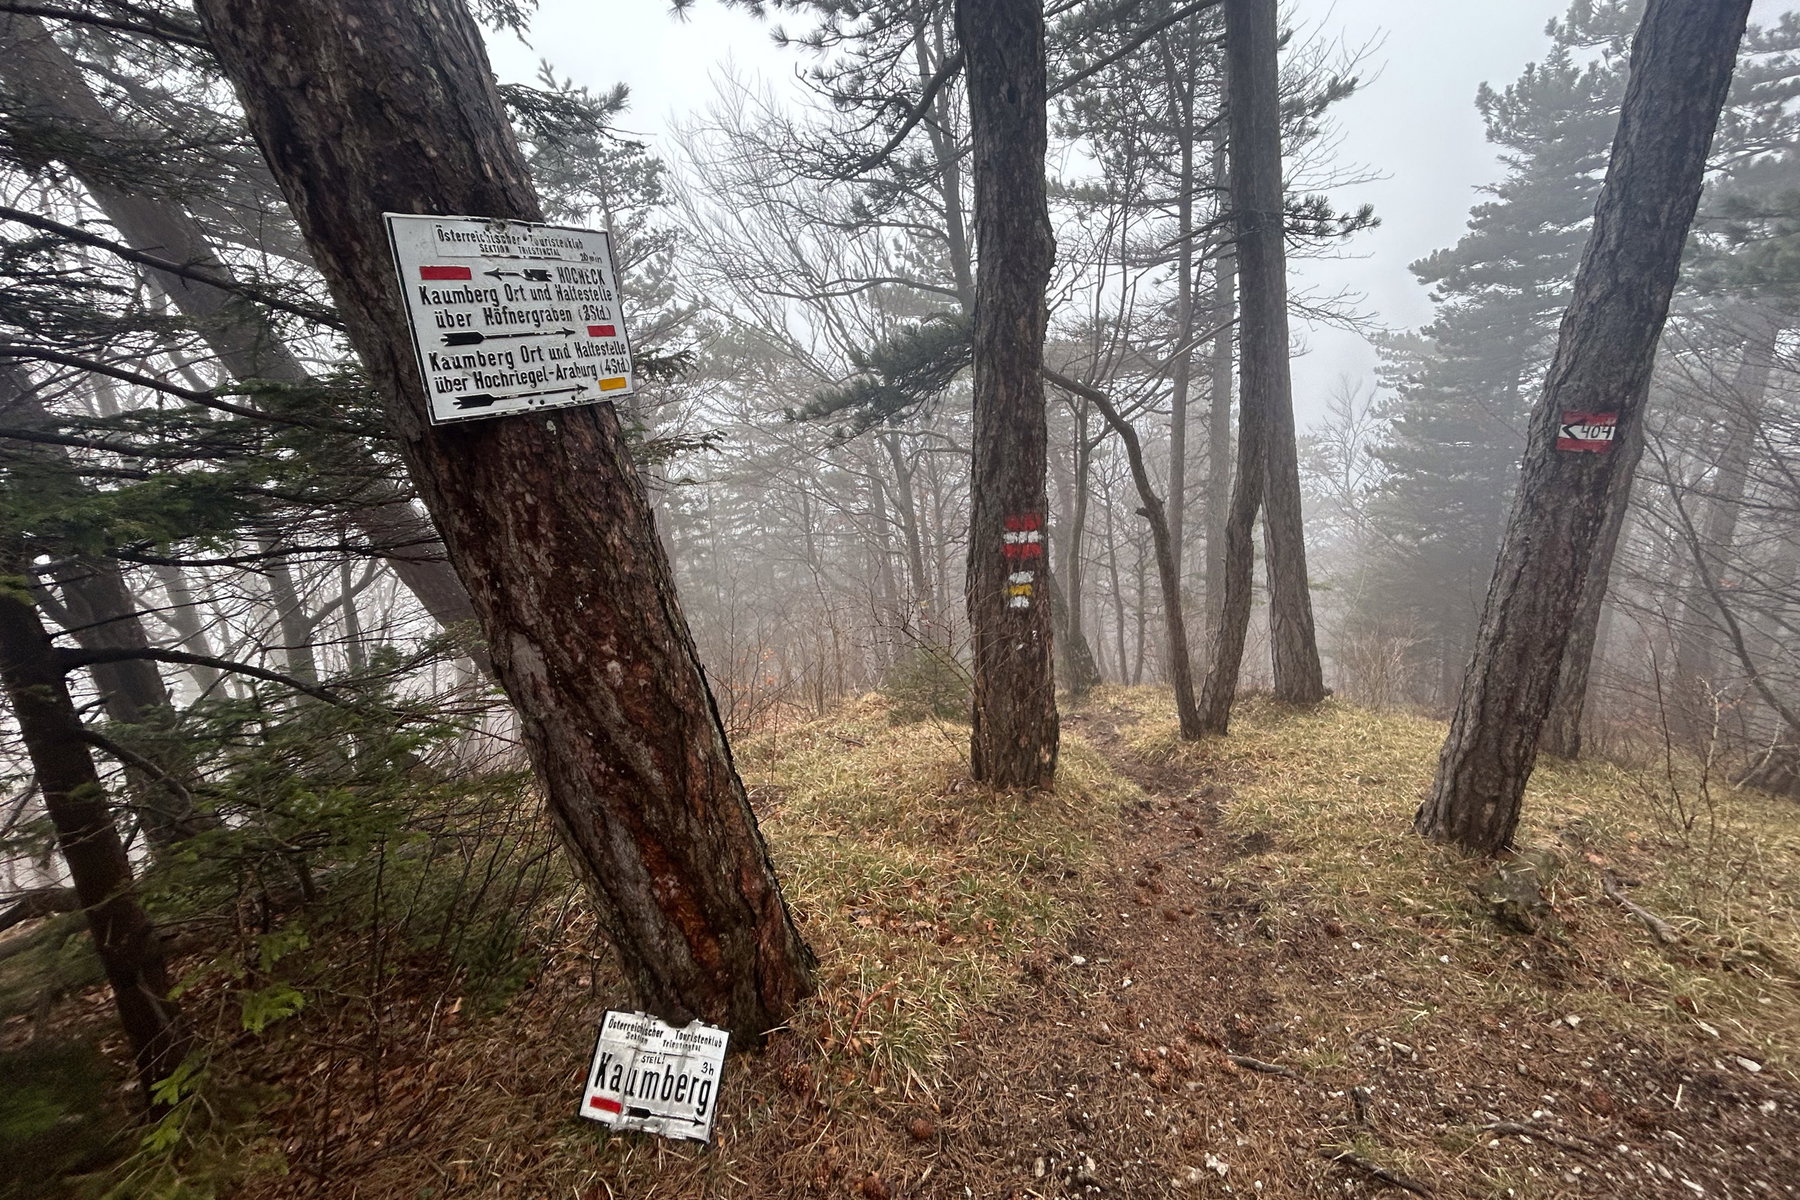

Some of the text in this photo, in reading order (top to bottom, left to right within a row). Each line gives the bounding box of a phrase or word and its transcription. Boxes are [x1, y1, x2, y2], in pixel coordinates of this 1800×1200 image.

[480, 244, 510, 253] SEKTION
[418, 283, 612, 306] Kaumberg Ort und Haltestelle
[434, 309, 472, 328] über
[483, 305, 572, 327] Höfnergraben
[428, 341, 626, 372] Kaumberg Ort und Haltestelle
[434, 375, 468, 394] über
[473, 362, 598, 389] Hochriegel-Araburg
[1581, 424, 1612, 439] 404
[608, 1016, 723, 1048] Österreichischer Touristenklub
[594, 1052, 712, 1116] Kaumberg
